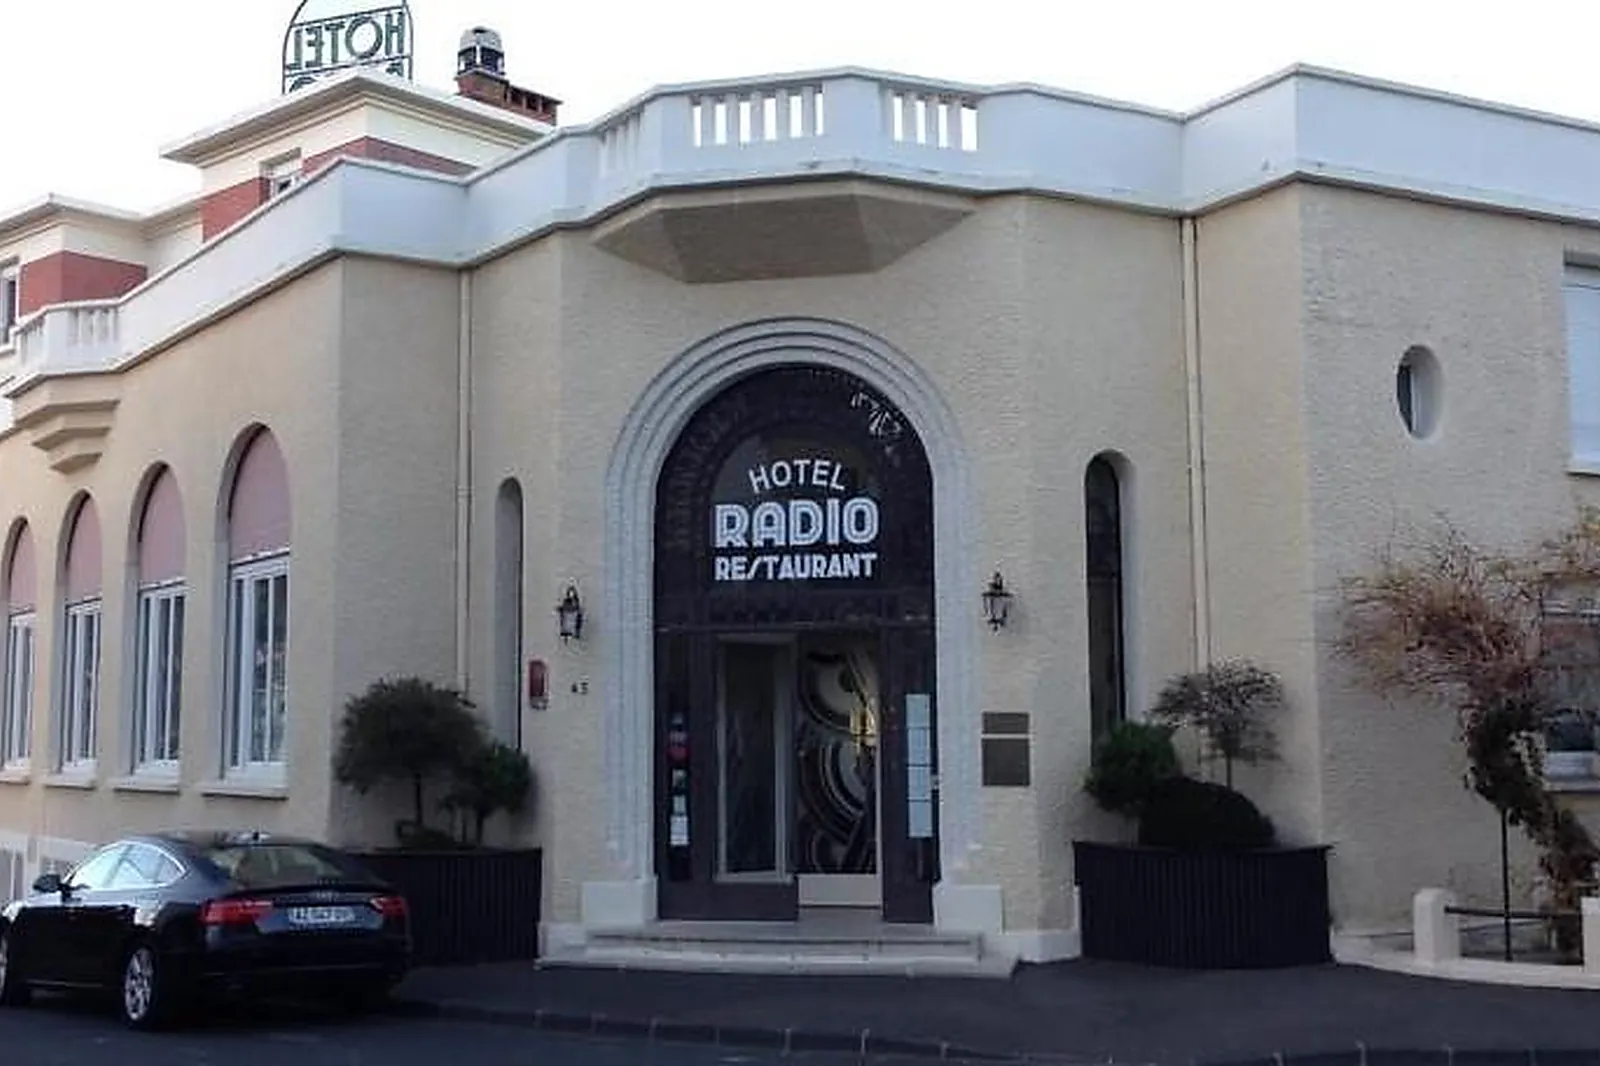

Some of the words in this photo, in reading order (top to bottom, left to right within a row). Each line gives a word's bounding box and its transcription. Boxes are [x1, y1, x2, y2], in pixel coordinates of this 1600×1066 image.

[748, 459, 845, 494] HOTEL
[715, 498, 879, 548] RADIO
[715, 553, 876, 580] RESTAURANT
